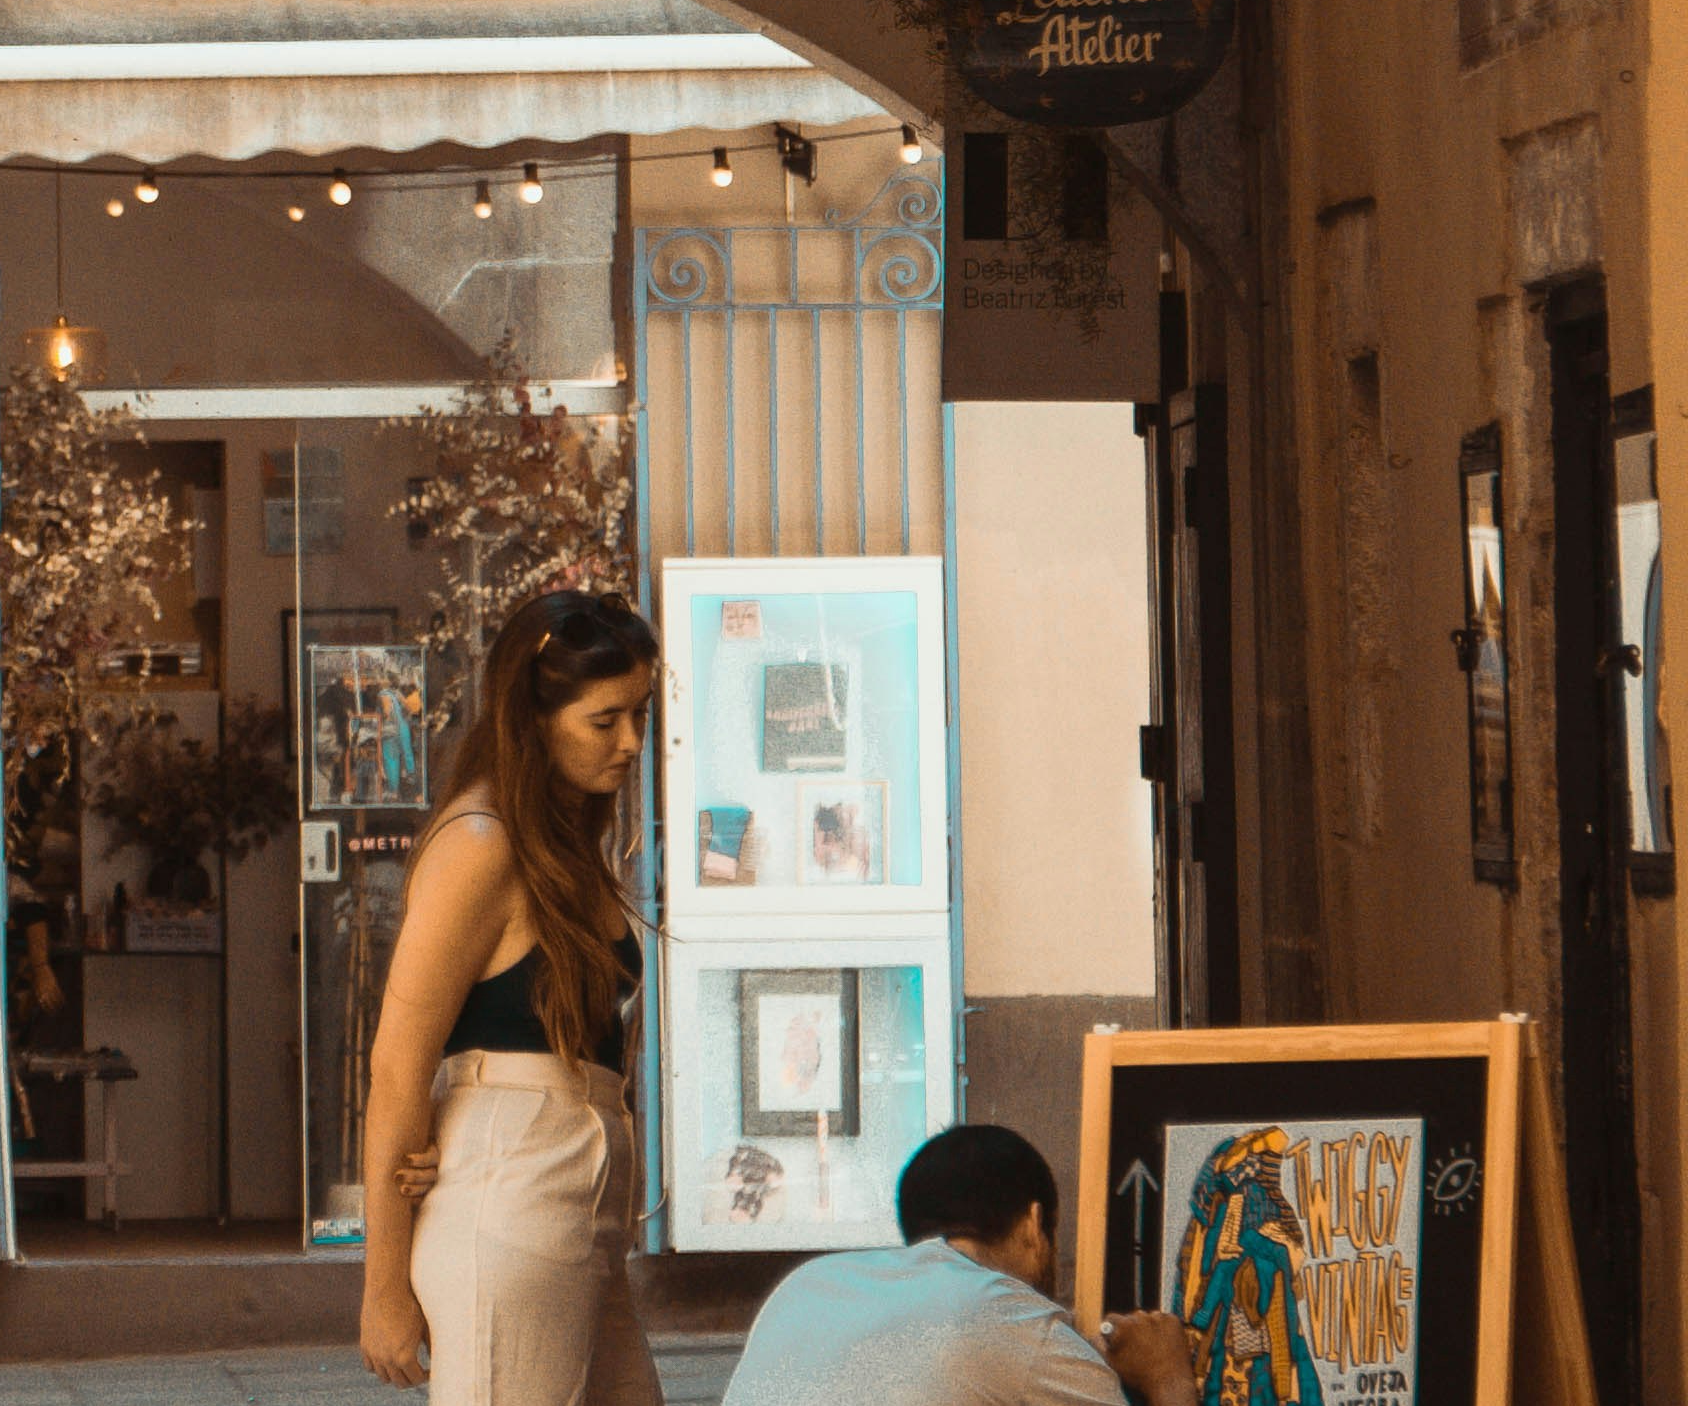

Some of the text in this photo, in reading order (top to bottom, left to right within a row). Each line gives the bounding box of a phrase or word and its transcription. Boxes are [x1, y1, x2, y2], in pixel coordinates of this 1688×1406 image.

[1028, 13, 1162, 77] Atelier
[964, 287, 1048, 309] Beatriz
[348, 836, 417, 851] @METR
[1286, 1131, 1411, 1259] TWIGGY
[1304, 1250, 1413, 1374] VINTAGE
[1356, 1370, 1408, 1394] OVEJA
